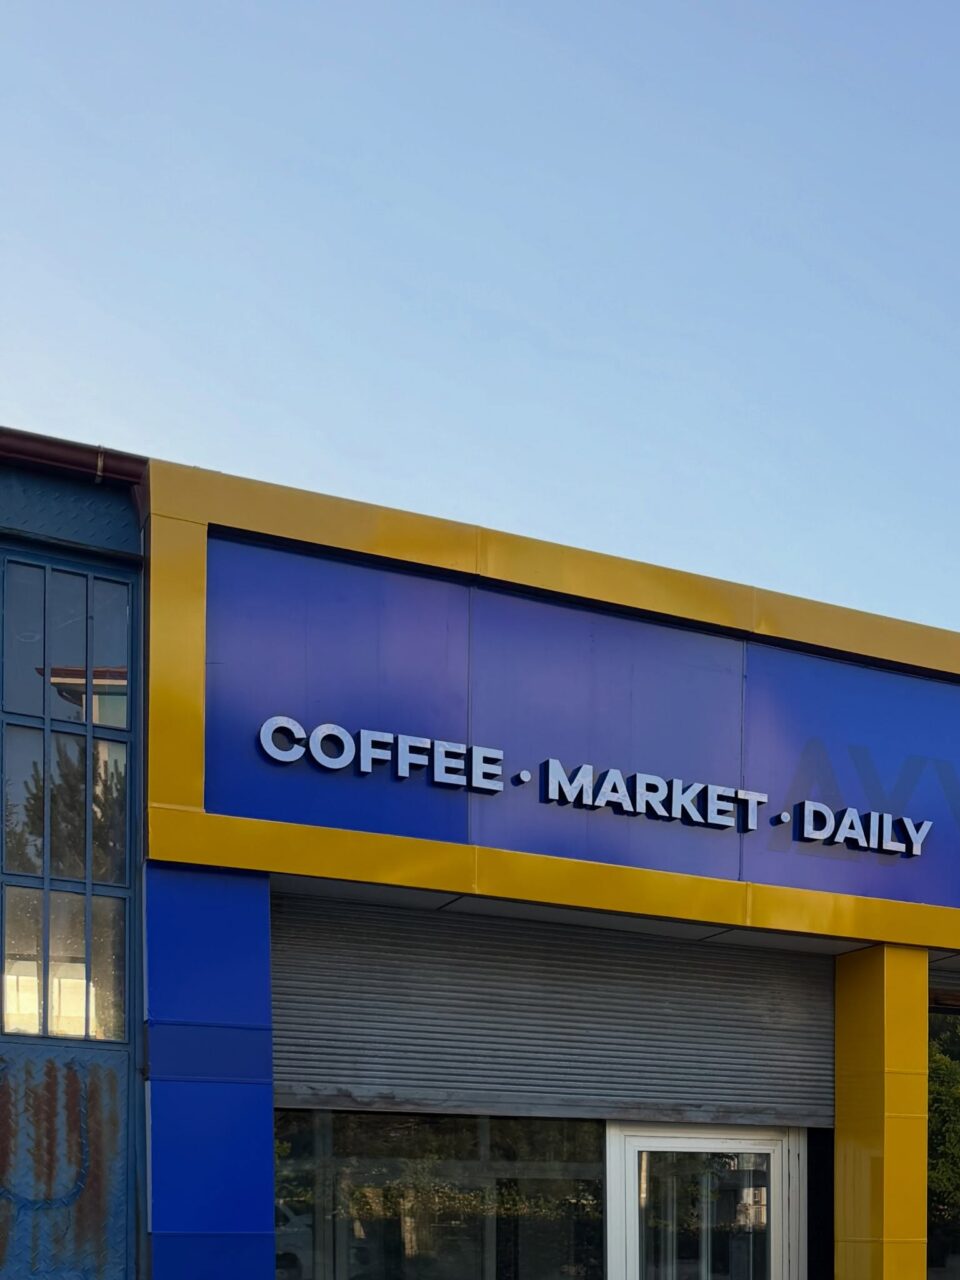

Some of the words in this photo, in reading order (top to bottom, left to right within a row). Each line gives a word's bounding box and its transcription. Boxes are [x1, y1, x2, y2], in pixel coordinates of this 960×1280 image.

[258, 714, 505, 793] COFFEE
[546, 757, 769, 832] MARKET
[802, 799, 934, 857] DAILY
